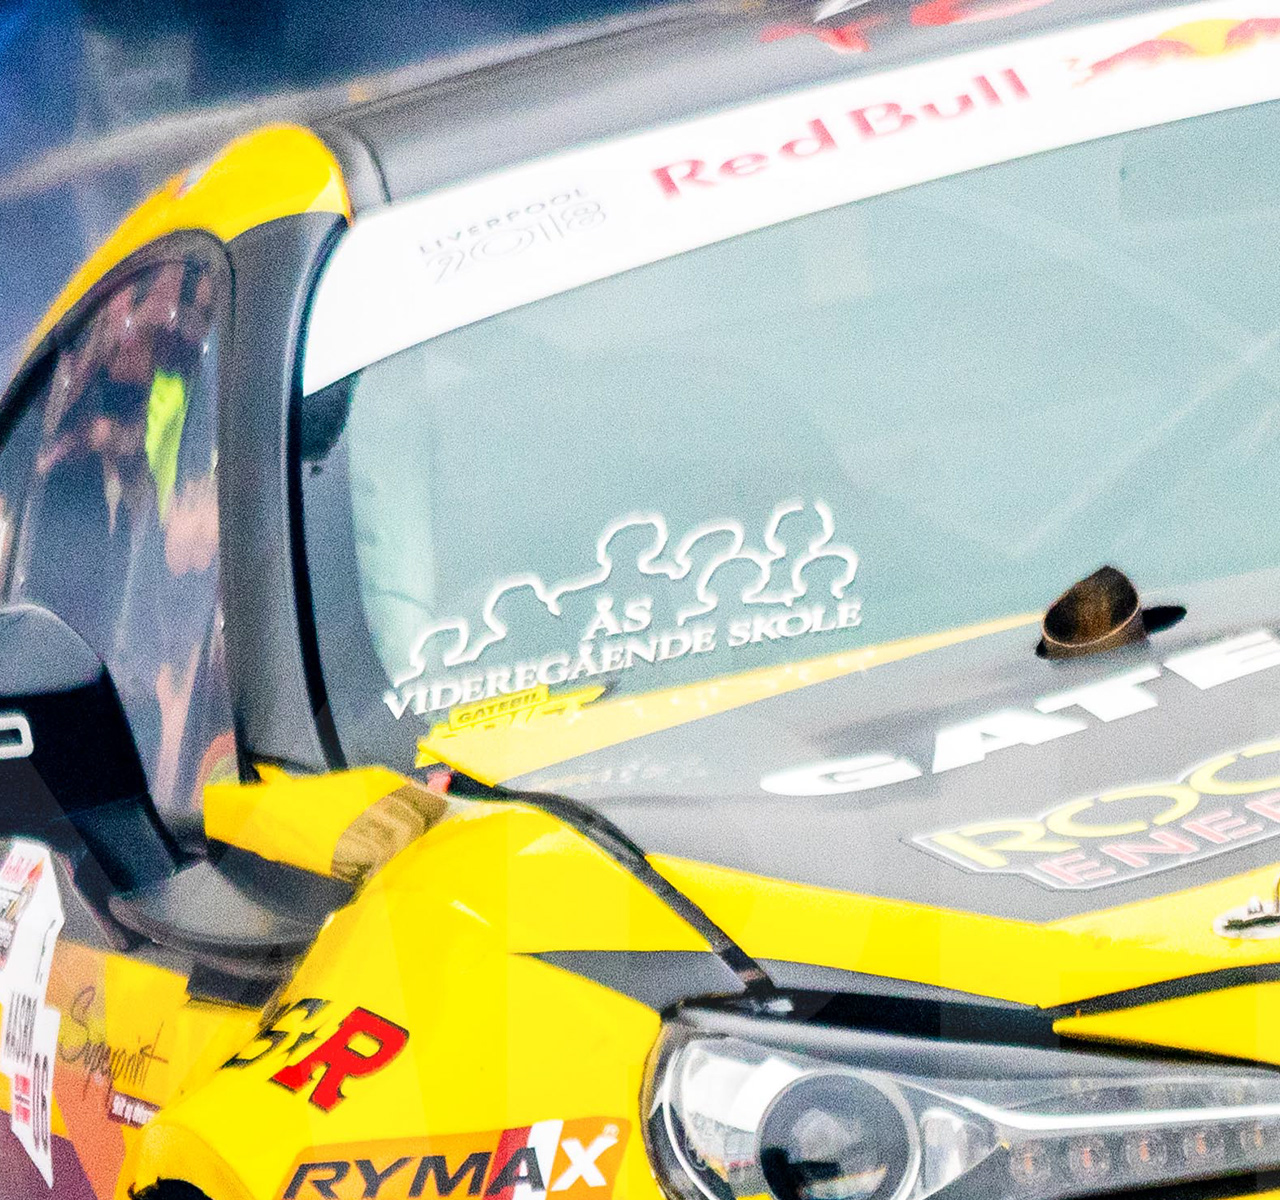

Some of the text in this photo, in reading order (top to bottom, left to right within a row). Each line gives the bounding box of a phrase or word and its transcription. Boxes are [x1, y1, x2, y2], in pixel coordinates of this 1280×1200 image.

[650, 67, 1031, 201] Red Bull
[418, 186, 583, 255] LIVERPOOL
[383, 601, 863, 720] VIDEREGÅENDE SKOLE
[585, 596, 653, 642] ÅS
